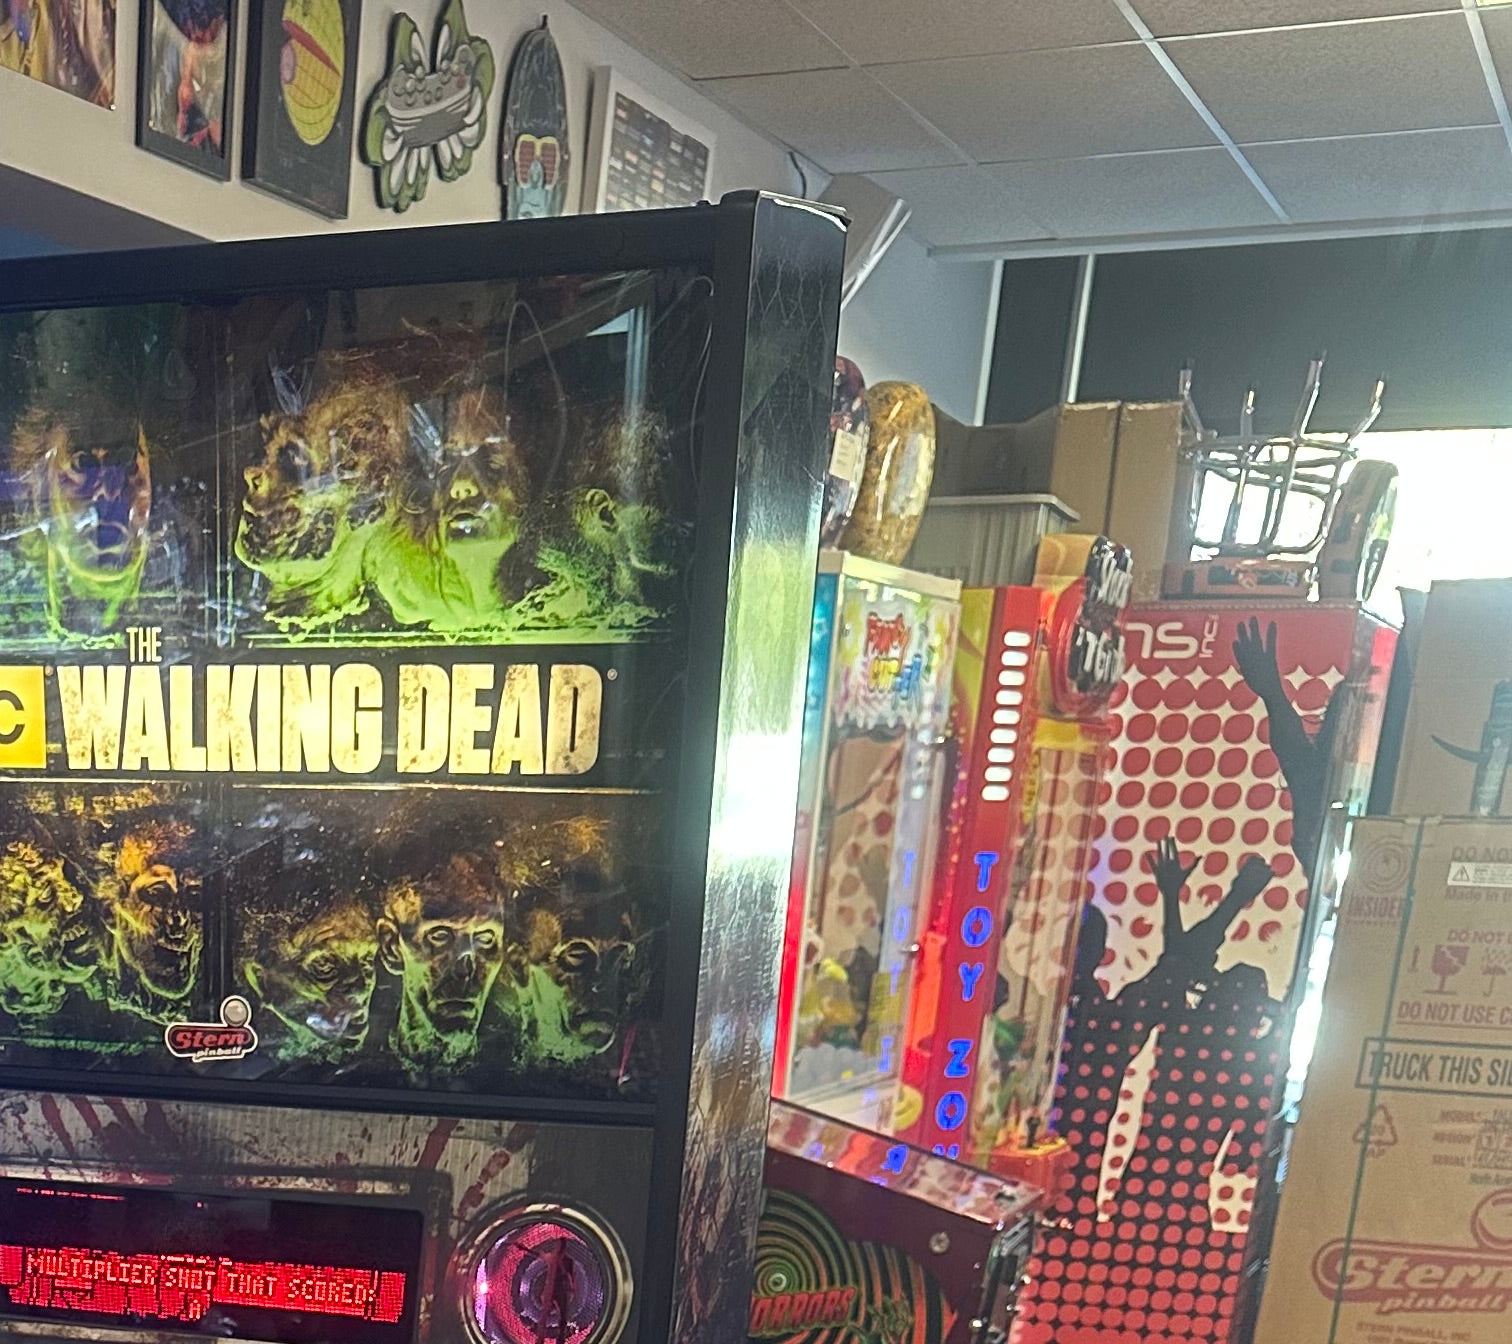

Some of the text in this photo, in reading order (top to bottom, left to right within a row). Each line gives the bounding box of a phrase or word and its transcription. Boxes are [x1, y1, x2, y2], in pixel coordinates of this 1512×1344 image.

[127, 627, 162, 662] THE
[58, 663, 383, 773] WALKING
[396, 663, 603, 776] DEAD
[1347, 892, 1405, 919] INSIDE
[931, 852, 999, 1160] TOY ZO
[1398, 1001, 1420, 1019] DO
[1425, 1003, 1458, 1022] NOT
[1463, 1006, 1495, 1024] USE
[175, 1031, 245, 1049] Stern
[1369, 1050, 1433, 1082] TRUCK
[1439, 1055, 1482, 1085] THIS
[26, 1253, 156, 1287] MULTIPLIER
[165, 1267, 218, 1291] SHOT
[227, 1275, 277, 1298] THAT
[1335, 1253, 1512, 1291] Stern
[1381, 1291, 1505, 1313] pinball
